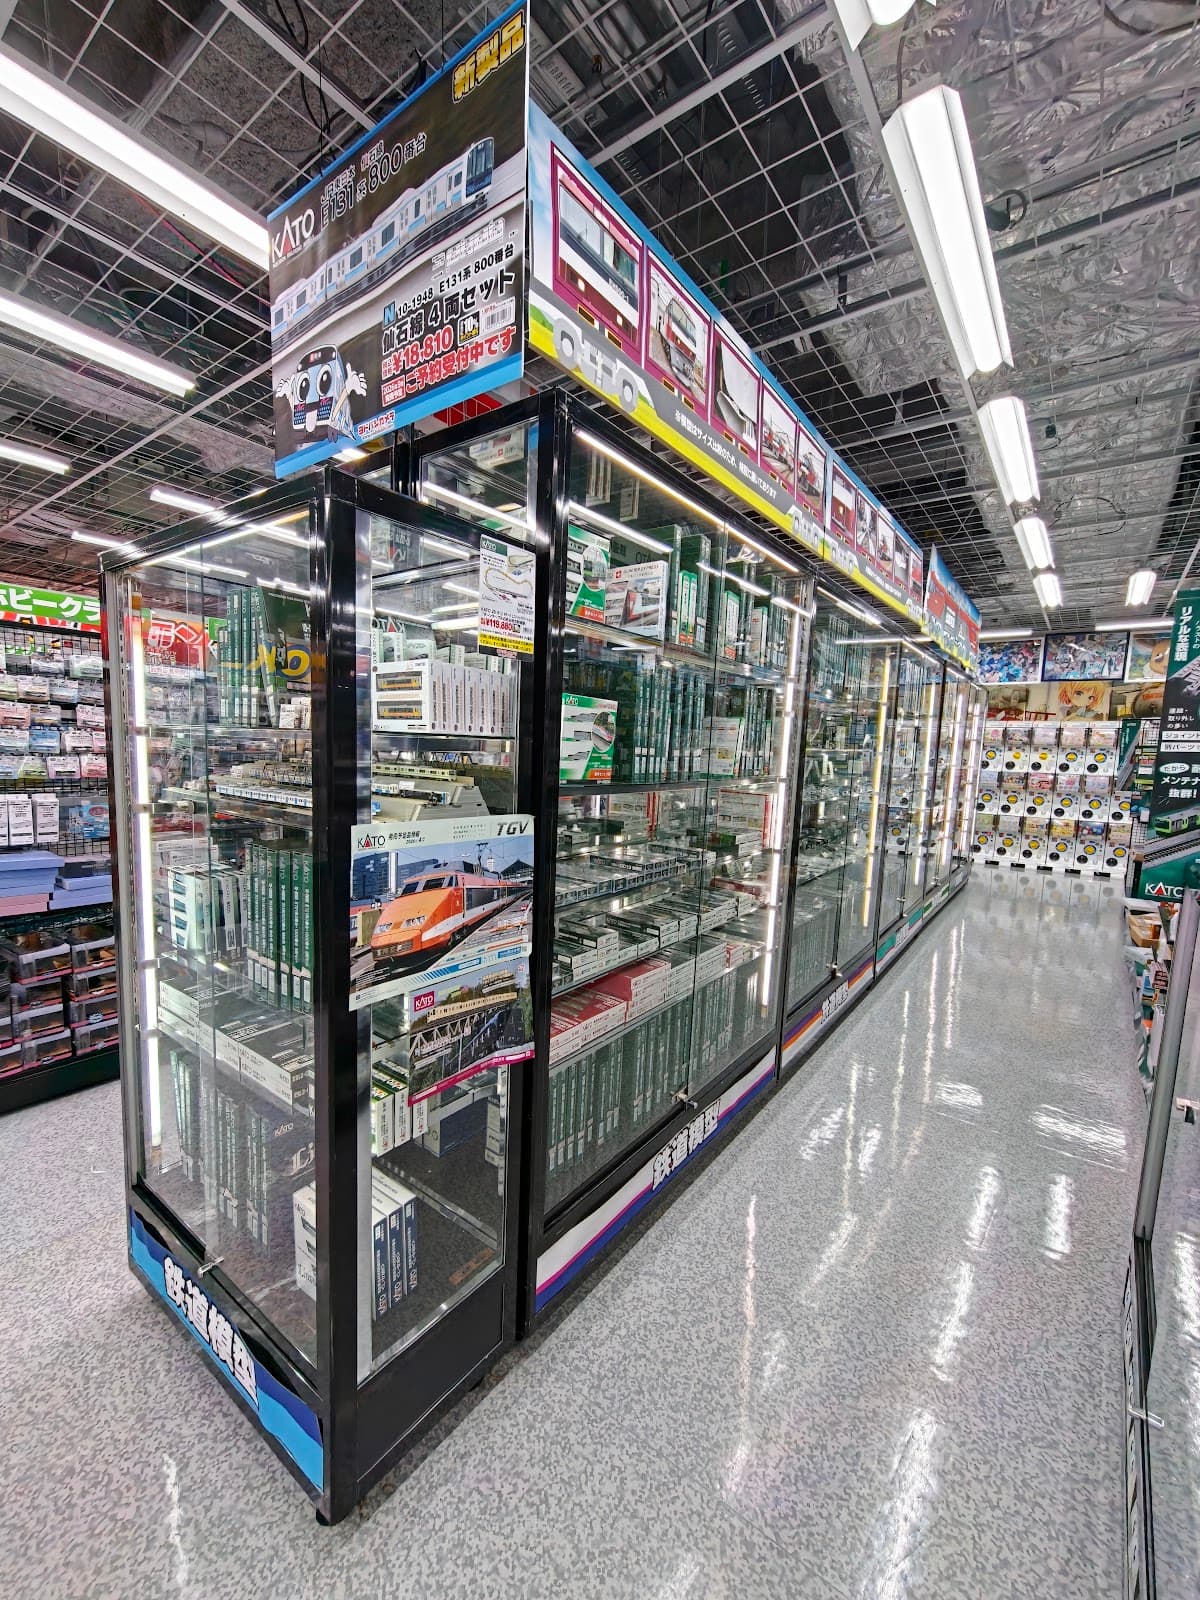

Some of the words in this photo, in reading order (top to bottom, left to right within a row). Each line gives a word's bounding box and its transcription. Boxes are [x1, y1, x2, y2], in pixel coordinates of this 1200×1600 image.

[453, 12, 525, 101] 新製品
[272, 208, 315, 264] KATO
[398, 287, 434, 318] 10-1948
[439, 264, 472, 293] E131系
[474, 241, 514, 274] 800番台
[383, 310, 425, 355] 仙石線
[405, 326, 516, 393] ご予約受付中です
[1174, 606, 1193, 662] リアルな表現
[357, 832, 386, 850] KATO
[496, 820, 529, 837] TGV
[415, 995, 434, 1008] KATO
[274, 1122, 294, 1137] KATO
[652, 1099, 721, 1191] 鉄道模型
[164, 1255, 260, 1410] 鉄道模型
